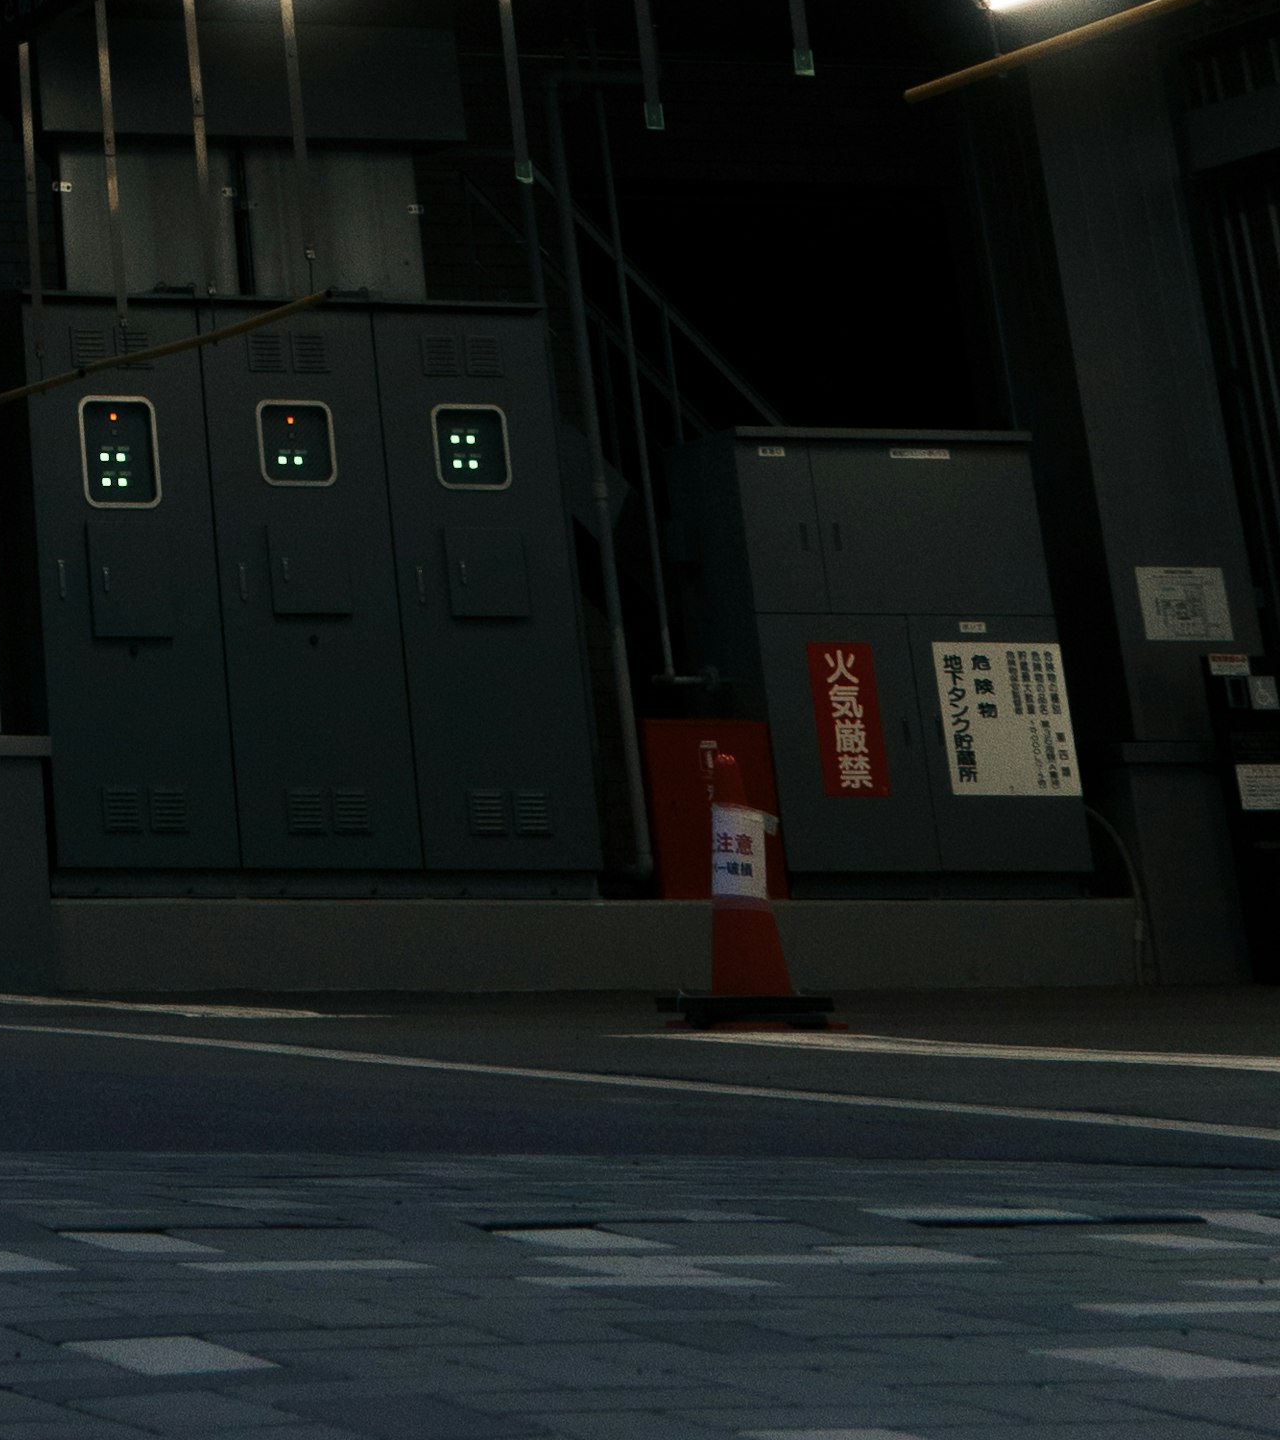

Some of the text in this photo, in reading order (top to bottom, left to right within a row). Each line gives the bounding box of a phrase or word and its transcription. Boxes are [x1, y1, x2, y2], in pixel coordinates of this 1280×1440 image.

[823, 648, 875, 790] 火気厳禁
[942, 654, 978, 784] 地下タンク貯蔵所
[970, 654, 999, 719] 危険物
[711, 832, 754, 856] 注意
